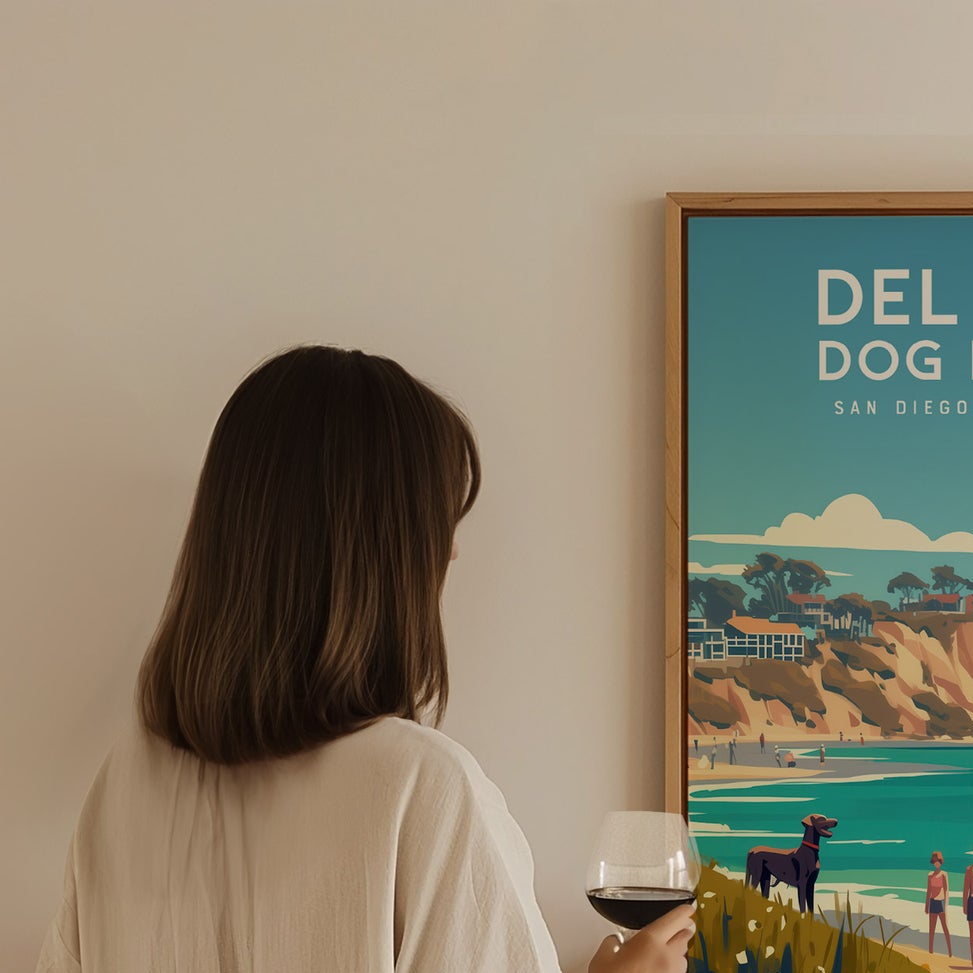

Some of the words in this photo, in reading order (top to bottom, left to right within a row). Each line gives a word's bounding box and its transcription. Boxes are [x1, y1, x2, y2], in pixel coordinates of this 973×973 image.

[818, 269, 958, 325] DEL
[818, 340, 942, 381] DOG
[834, 400, 877, 415] SAN
